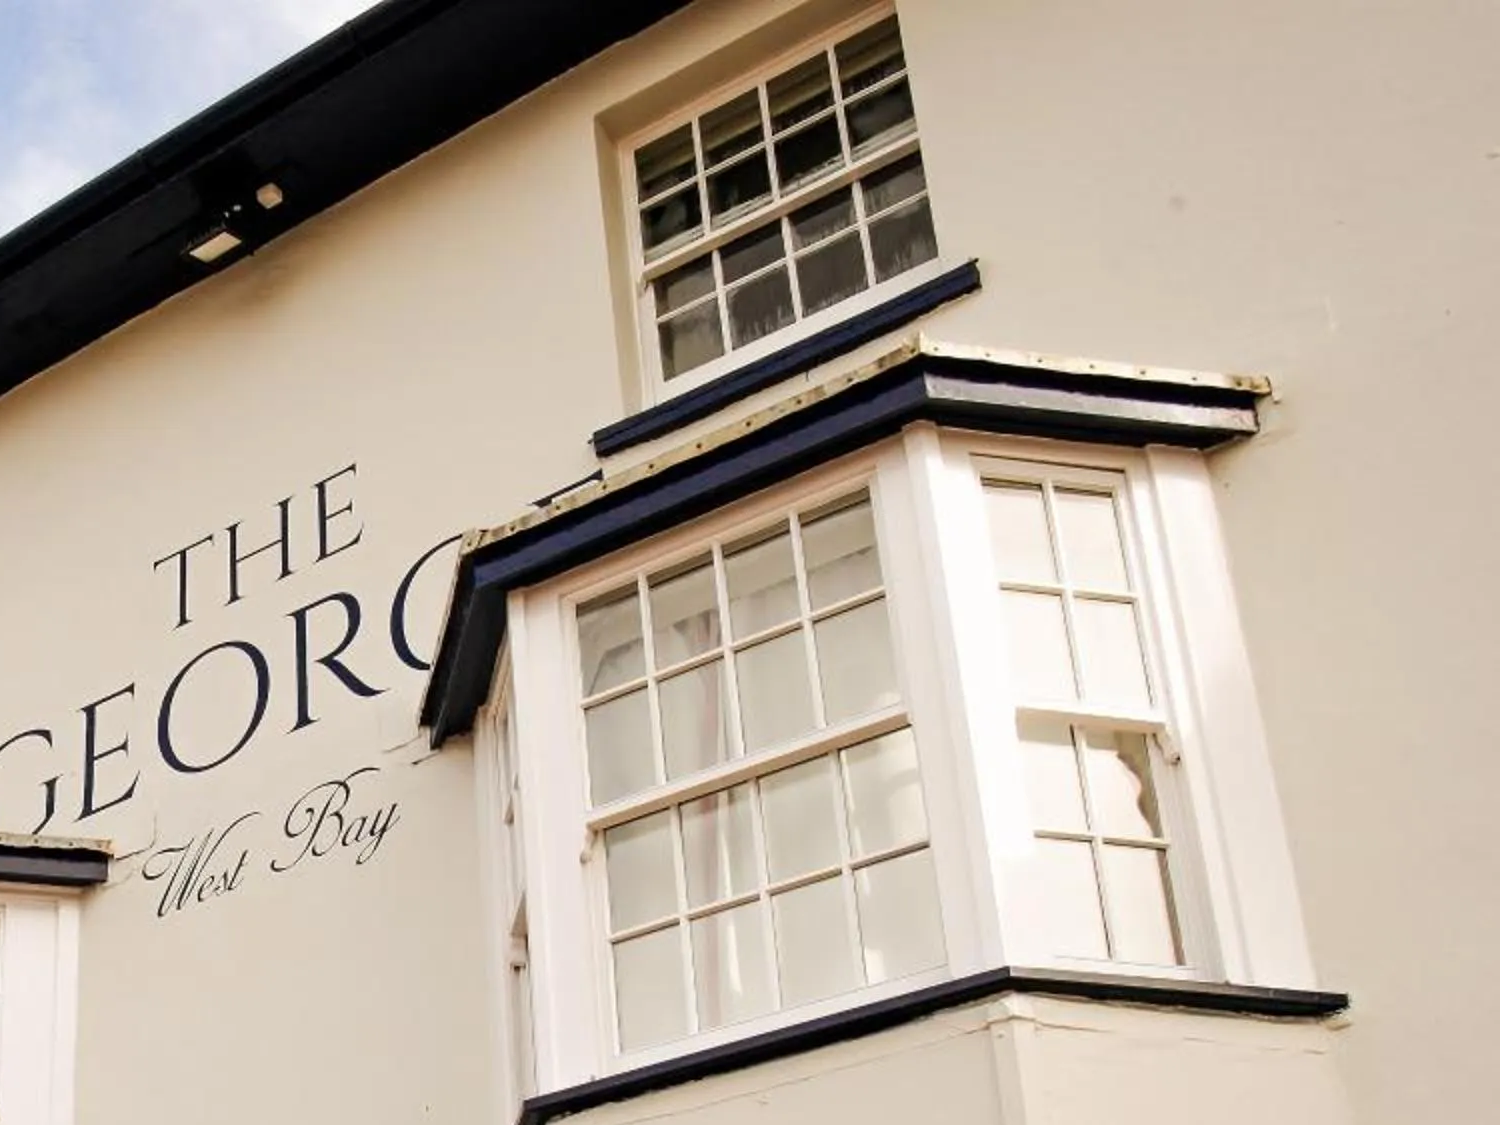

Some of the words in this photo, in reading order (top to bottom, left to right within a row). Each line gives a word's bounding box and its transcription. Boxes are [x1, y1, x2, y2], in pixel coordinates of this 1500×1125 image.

[152, 462, 366, 630] THE
[141, 811, 260, 918] West
[269, 766, 400, 867] Bay
